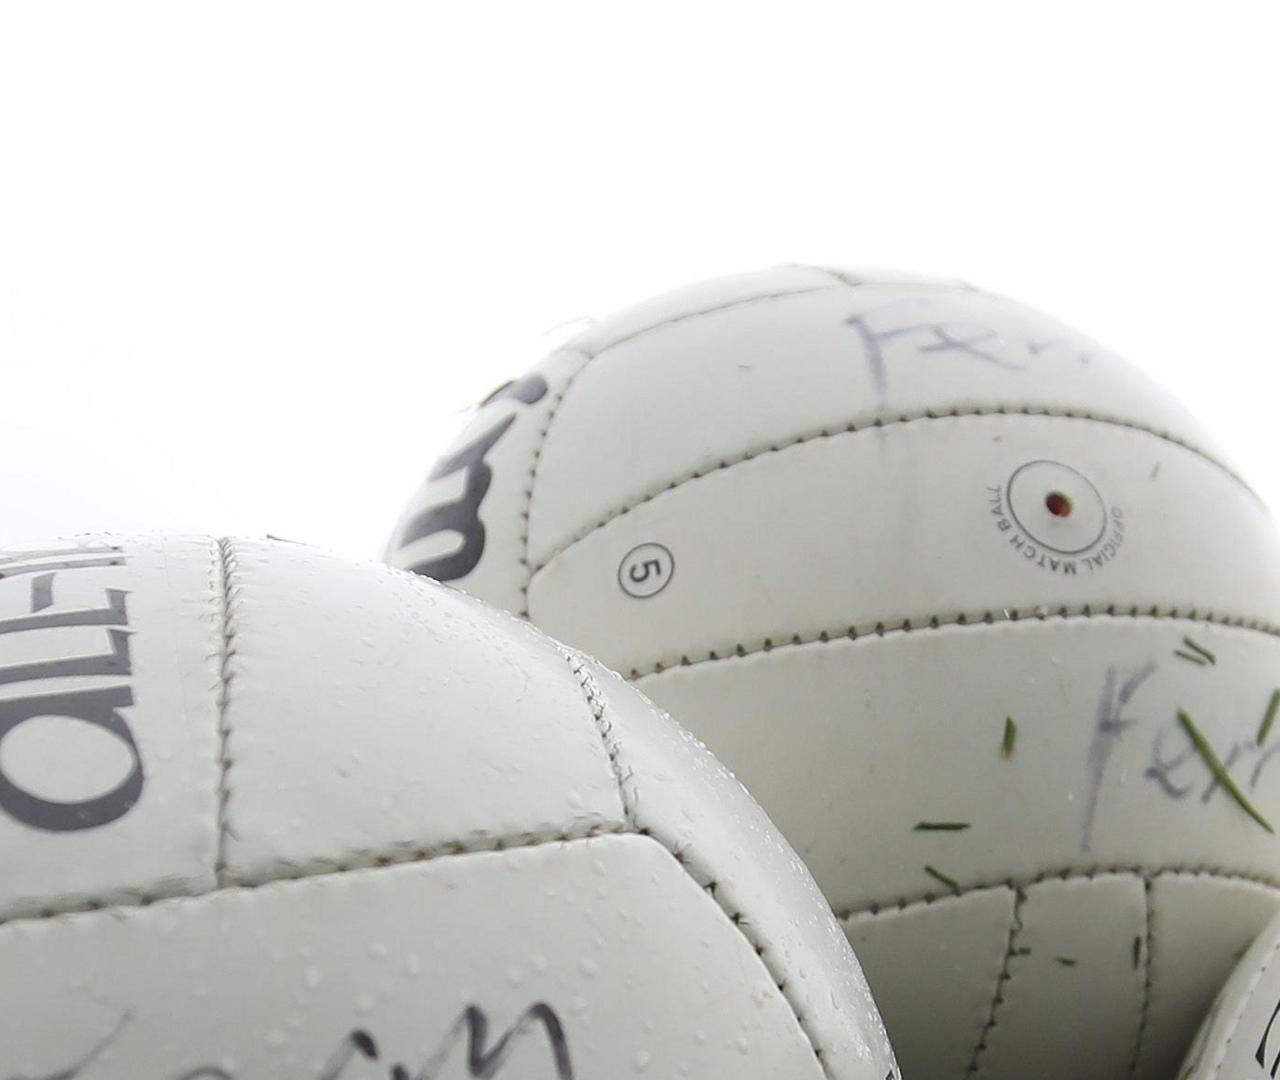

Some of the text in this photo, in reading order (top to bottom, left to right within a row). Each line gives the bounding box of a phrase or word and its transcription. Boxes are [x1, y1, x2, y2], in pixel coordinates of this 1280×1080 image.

[986, 484, 1126, 576] OFFICIAL MATCH BALL
